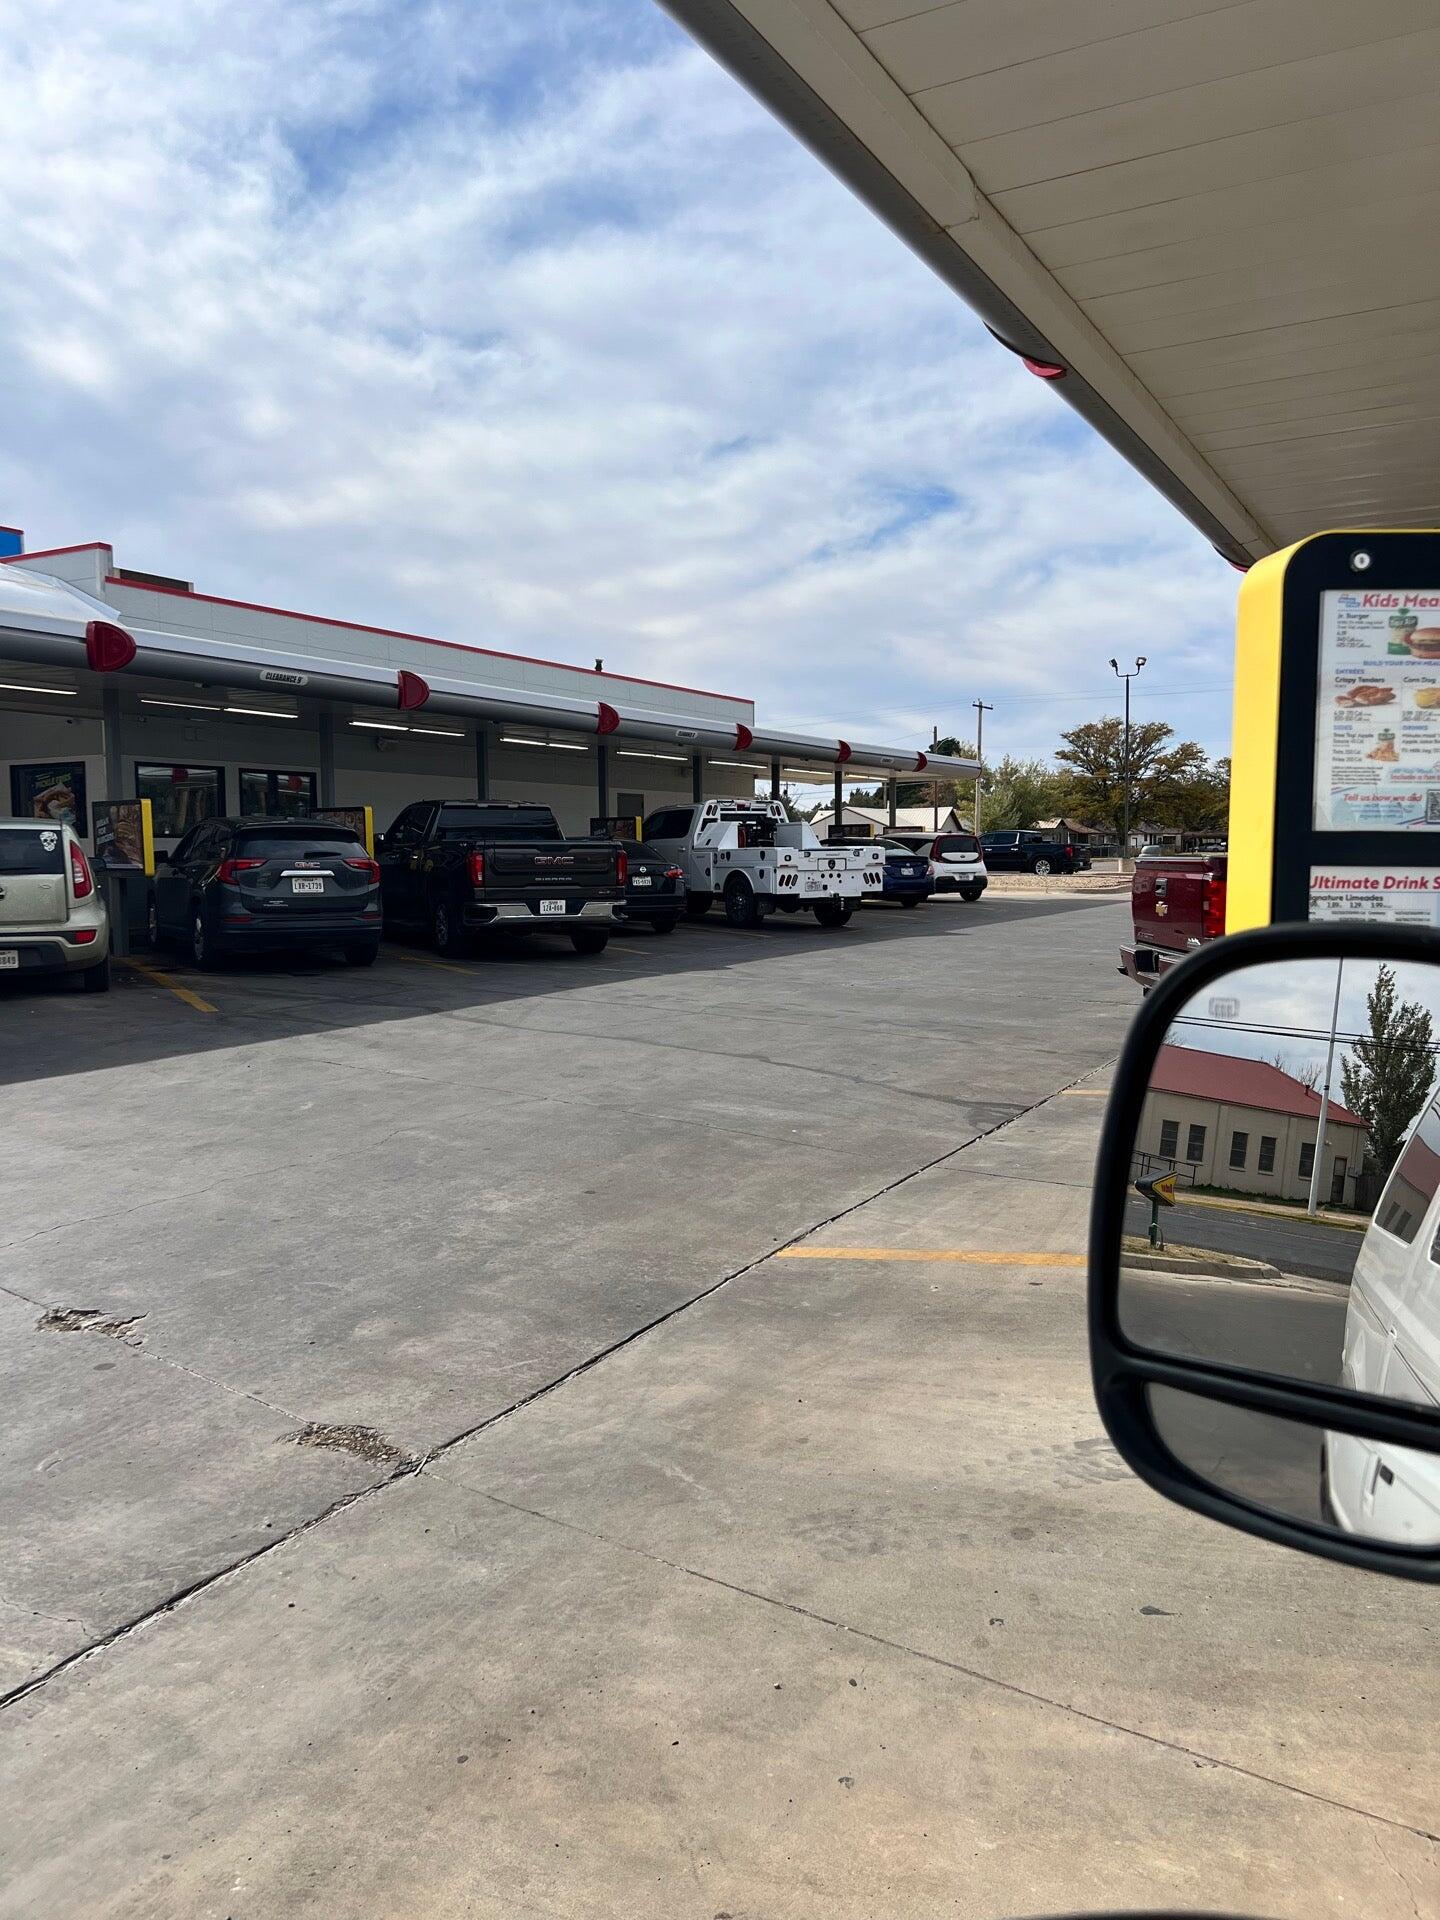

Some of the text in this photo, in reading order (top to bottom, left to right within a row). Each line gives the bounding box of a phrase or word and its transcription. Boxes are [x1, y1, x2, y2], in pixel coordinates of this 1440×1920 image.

[1363, 593, 1400, 608] Kids
[1404, 593, 1440, 608] Mea
[265, 672, 297, 683] CLEARANCE
[1335, 676, 1357, 684] Crispy
[1421, 676, 1437, 684] Dog
[1344, 794, 1358, 802] Tell
[1371, 794, 1391, 802] how
[534, 856, 574, 865] GMC
[1383, 875, 1429, 889] Drink
[1432, 875, 1440, 889] S
[1345, 894, 1384, 902] Limeades
